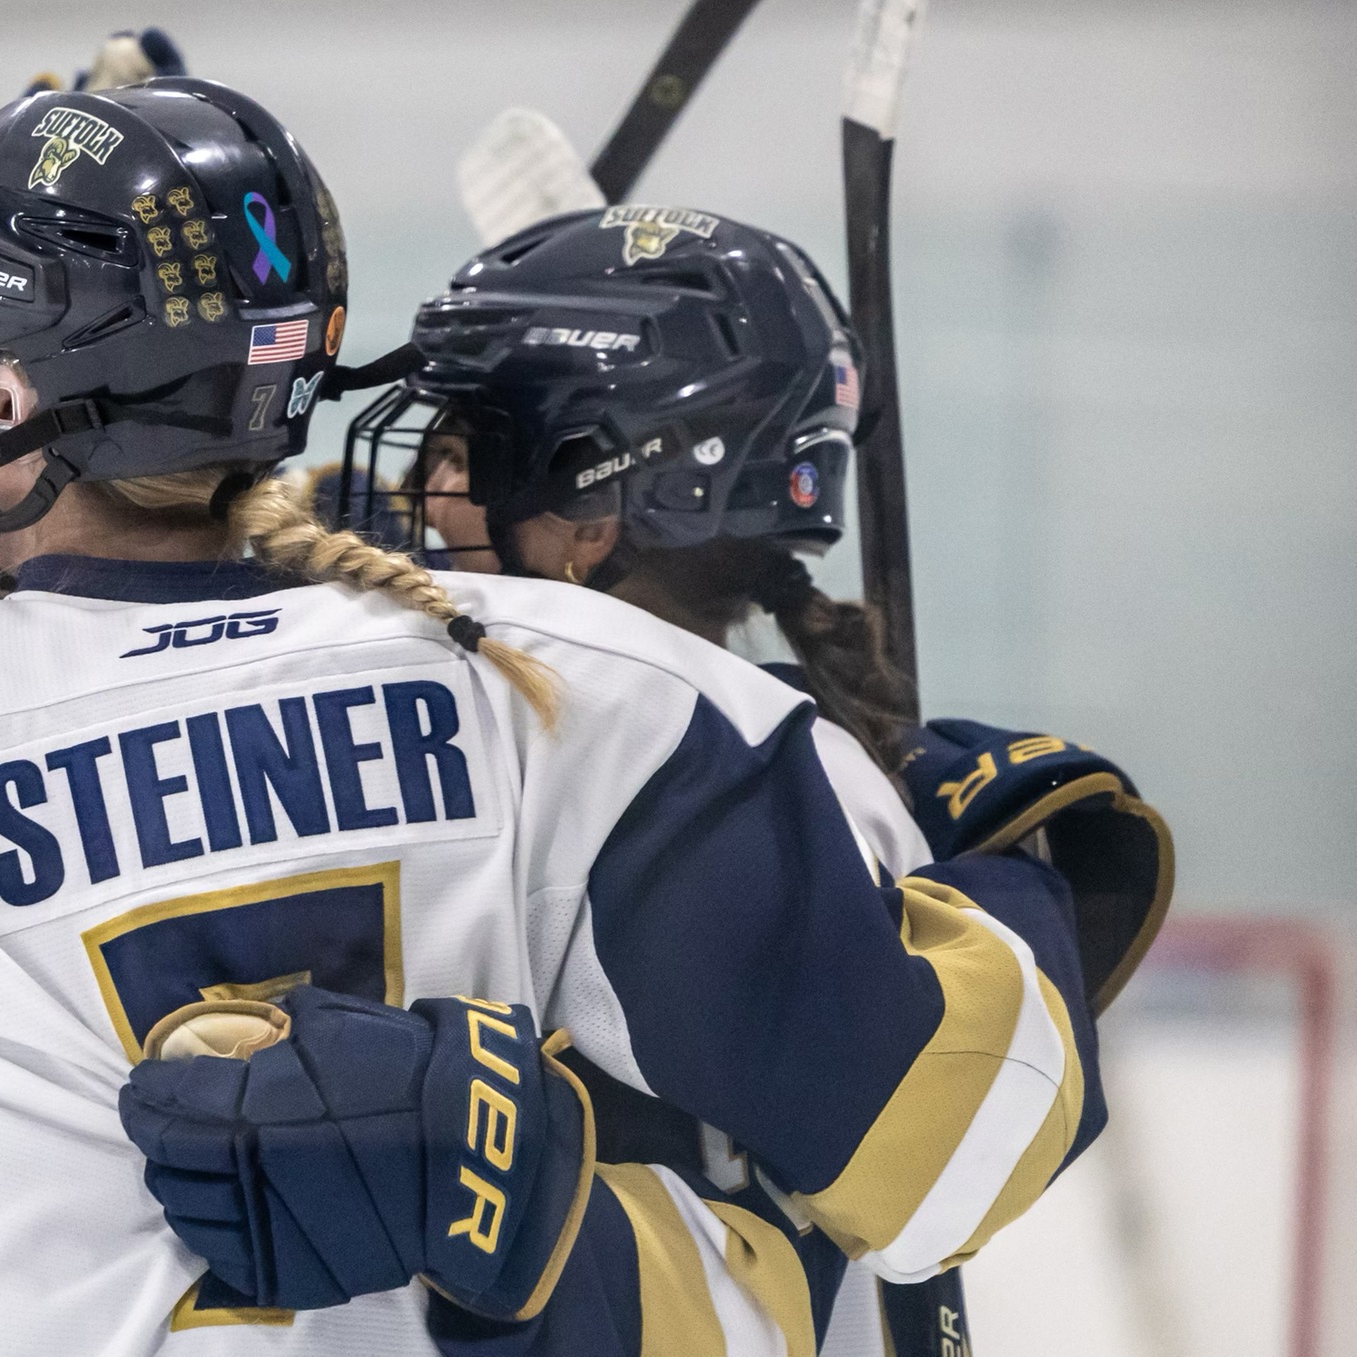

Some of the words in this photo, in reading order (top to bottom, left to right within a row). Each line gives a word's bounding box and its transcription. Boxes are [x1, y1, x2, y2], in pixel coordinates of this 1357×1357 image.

[33, 107, 124, 165] SUFFOLK
[599, 205, 719, 238] SUFFOLK
[522, 327, 640, 351] BAUER
[249, 385, 276, 430] 7
[576, 438, 662, 489] BAUR
[119, 608, 283, 658] JOG
[448, 995, 521, 1254] UER
